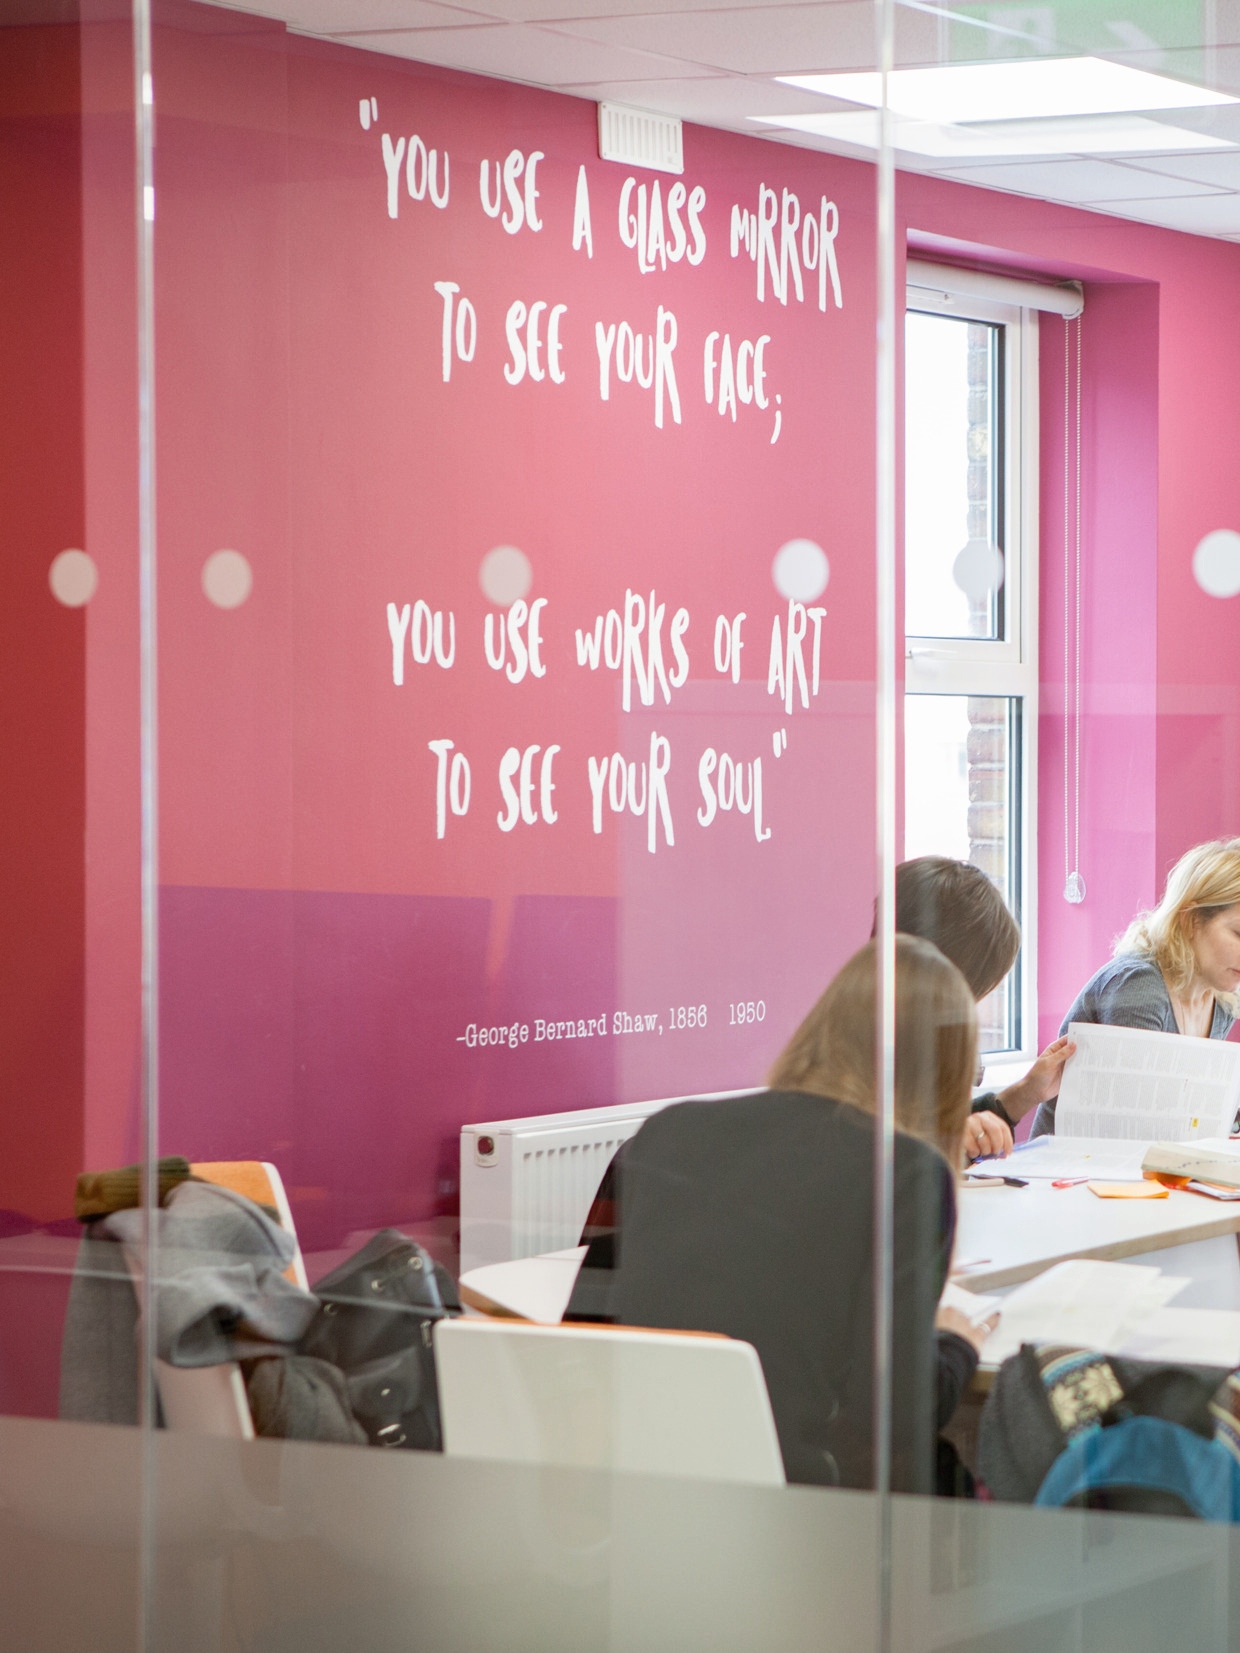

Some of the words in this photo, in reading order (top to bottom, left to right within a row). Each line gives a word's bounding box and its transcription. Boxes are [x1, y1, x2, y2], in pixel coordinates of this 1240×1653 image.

[480, 149, 544, 234] USE
[572, 165, 593, 259] A
[619, 176, 706, 274] GLASS
[730, 182, 843, 312] MIRROR
[434, 281, 477, 382] TO
[504, 300, 567, 385] SEE
[596, 305, 681, 428] YOUR
[704, 331, 782, 444] FACE;
[387, 600, 455, 685] YOU
[484, 598, 548, 683] USE
[575, 588, 690, 712] WORKS
[713, 612, 746, 683] OF
[768, 598, 827, 715] ART
[428, 739, 471, 839] TO
[497, 744, 560, 832] SEE
[588, 731, 675, 853] YOUR
[698, 728, 787, 842] SOUL"
[534, 1014, 607, 1042] Bernard
[613, 1011, 663, 1035] Shaw,
[669, 1004, 708, 1030] 1856
[729, 1000, 766, 1025] 1950
